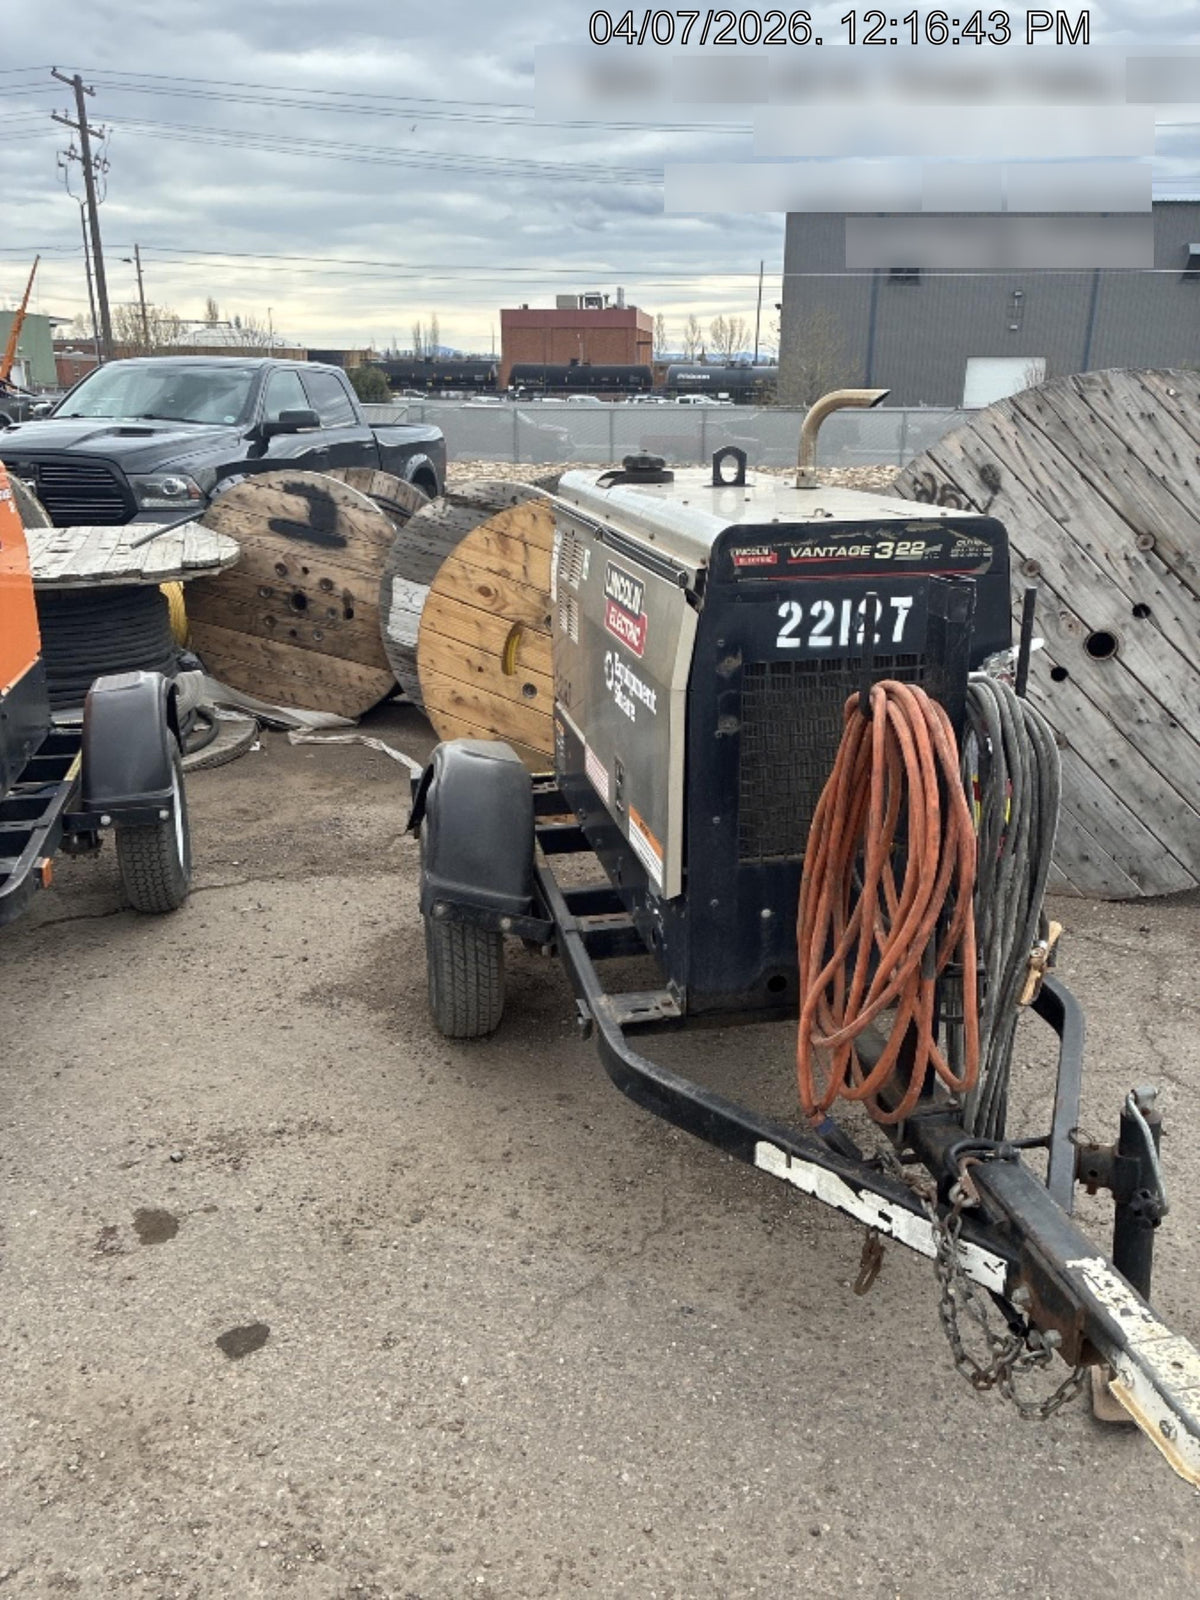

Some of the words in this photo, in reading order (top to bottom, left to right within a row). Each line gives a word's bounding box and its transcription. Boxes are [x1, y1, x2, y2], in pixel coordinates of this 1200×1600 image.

[790, 545, 872, 558] VANTAGE
[874, 541, 926, 559] 322
[605, 566, 642, 617] LINCOLN
[609, 605, 641, 647] ELECTRIC
[776, 596, 913, 648] 22127
[614, 652, 657, 715] Equipment
[614, 681, 636, 722] Share
